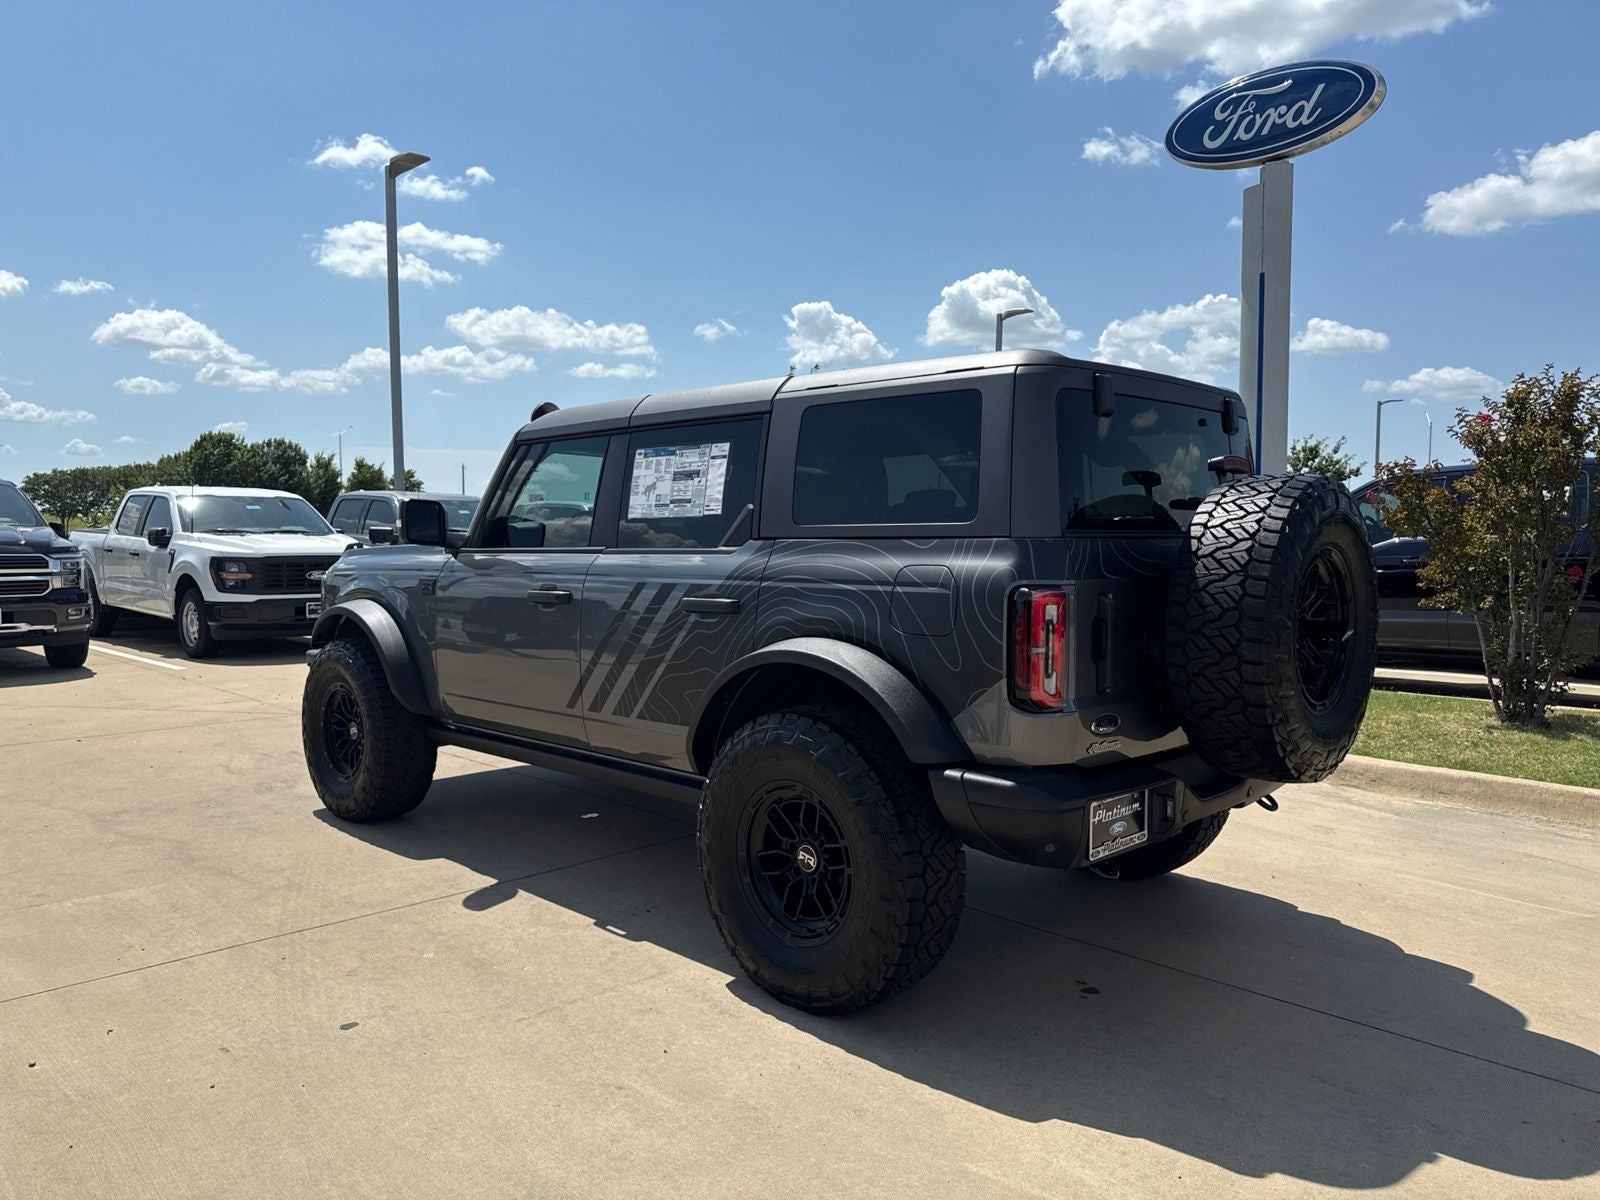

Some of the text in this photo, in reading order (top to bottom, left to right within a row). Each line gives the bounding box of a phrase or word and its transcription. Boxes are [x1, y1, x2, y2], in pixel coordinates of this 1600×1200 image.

[1202, 77, 1325, 149] Ford
[1091, 802, 1142, 825] Platinum
[1102, 838, 1137, 855] Platinum
